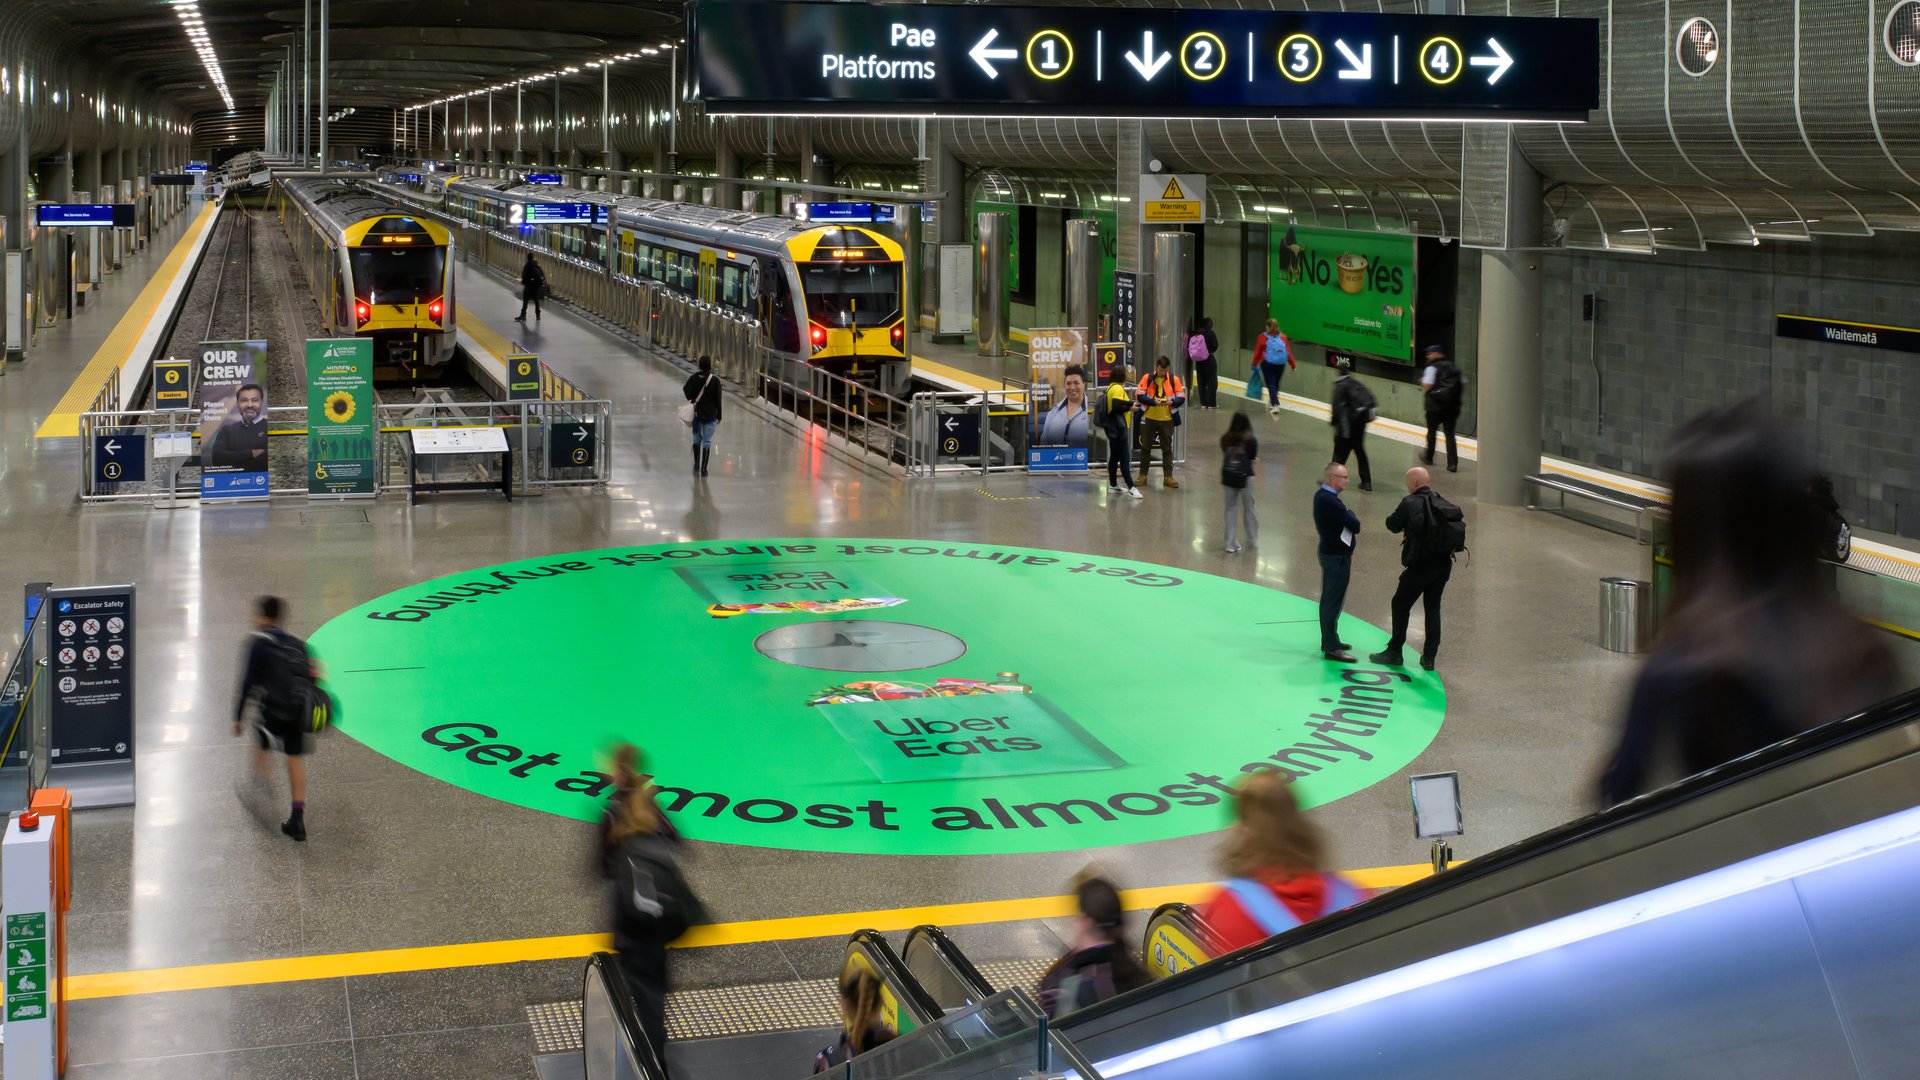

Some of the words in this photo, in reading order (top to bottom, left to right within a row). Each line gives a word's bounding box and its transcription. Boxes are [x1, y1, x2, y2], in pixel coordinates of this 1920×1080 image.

[891, 23, 936, 47] Pae
[1041, 40, 1060, 69] 1
[1194, 41, 1212, 70] 2
[1291, 43, 1309, 73] 3
[1431, 45, 1449, 73] 4
[822, 54, 936, 79] Platforms
[510, 204, 523, 224] 2
[795, 203, 808, 221] 3
[1160, 203, 1187, 211] Warning
[1300, 249, 1331, 286] No
[1362, 254, 1403, 295] Yes
[1354, 317, 1377, 327] Exclusive
[1032, 336, 1061, 349] OUR
[1825, 327, 1877, 344] Waitematā
[203, 350, 237, 364] OUR
[1032, 350, 1073, 363] CREW
[203, 365, 250, 379] CREW
[948, 440, 955, 450] 2
[577, 450, 584, 461] 2
[109, 465, 116, 476] 1
[597, 545, 817, 567] almost
[837, 544, 1060, 565] almost
[727, 571, 836, 582] Eats
[1066, 562, 1184, 587] Get
[367, 561, 597, 622] anything
[742, 581, 850, 592] Uber
[73, 602, 103, 610] Escalator
[873, 716, 1010, 737] Uber
[421, 722, 562, 779] Get
[929, 772, 1242, 831] almost
[1240, 668, 1412, 785] anything
[892, 735, 1042, 759] Eats
